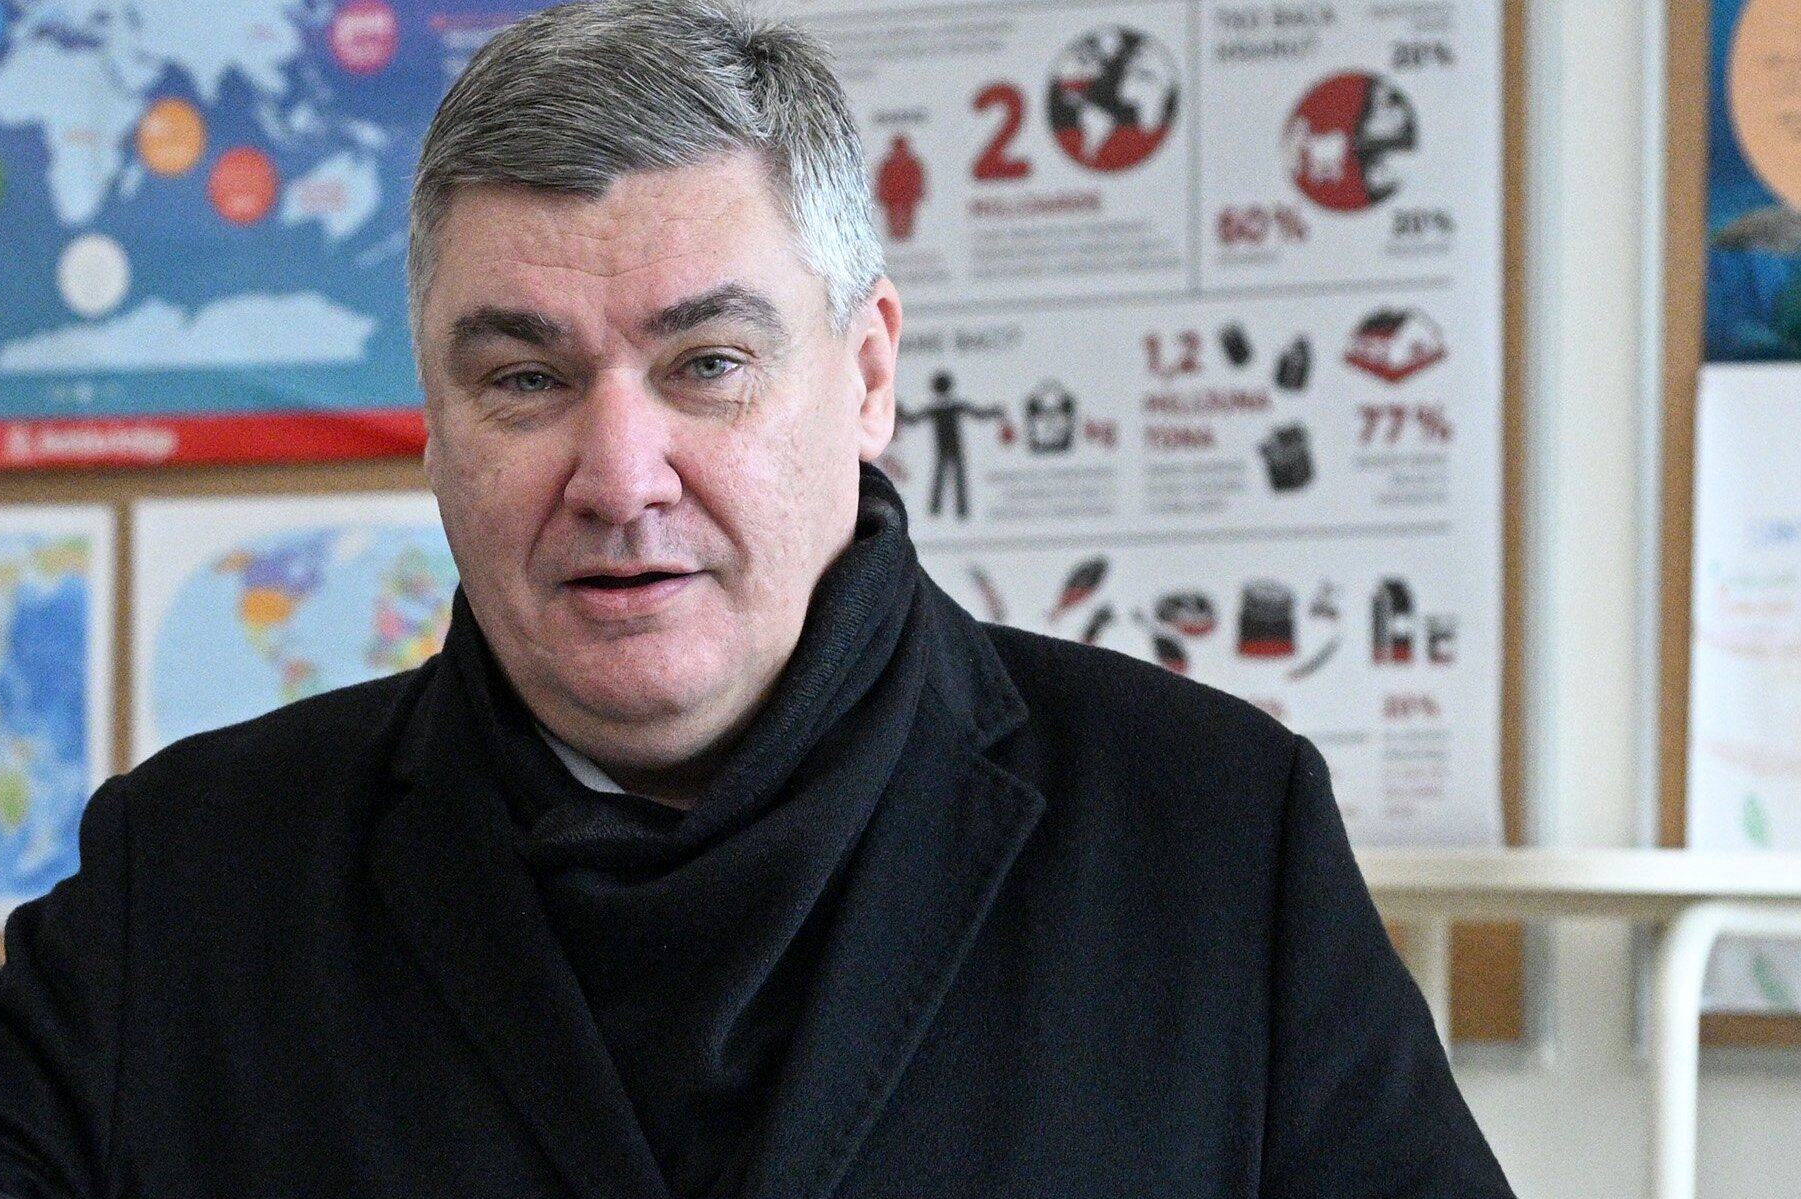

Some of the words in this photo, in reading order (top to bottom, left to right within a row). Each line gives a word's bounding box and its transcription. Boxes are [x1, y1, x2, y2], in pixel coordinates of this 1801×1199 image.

[970, 81, 1032, 181] 2
[1143, 331, 1202, 380] 1,2
[1356, 402, 1451, 441] 77%
